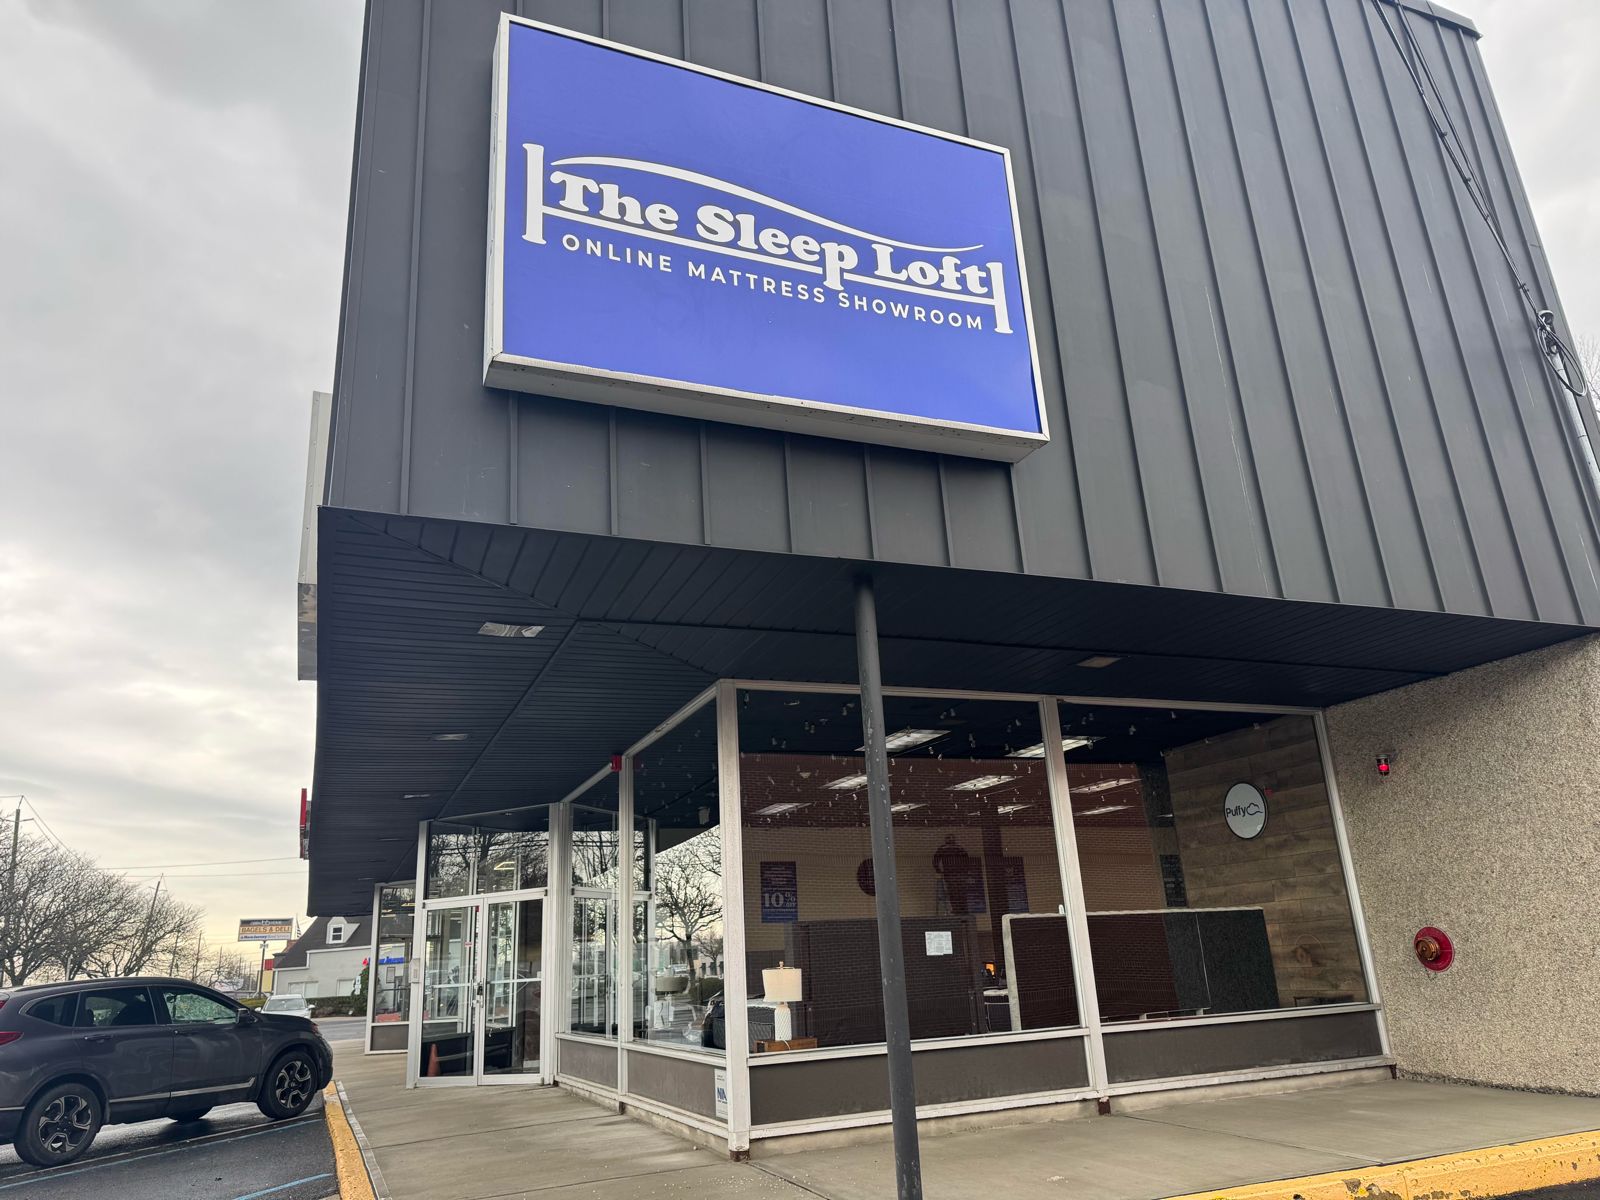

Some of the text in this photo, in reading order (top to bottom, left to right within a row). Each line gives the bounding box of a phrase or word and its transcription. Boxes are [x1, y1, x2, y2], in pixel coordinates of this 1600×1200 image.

[550, 171, 989, 295] The Sleep Loft
[562, 233, 983, 330] ONLINE MATTRESS SHOWROOM
[1226, 805, 1247, 818] Puffy
